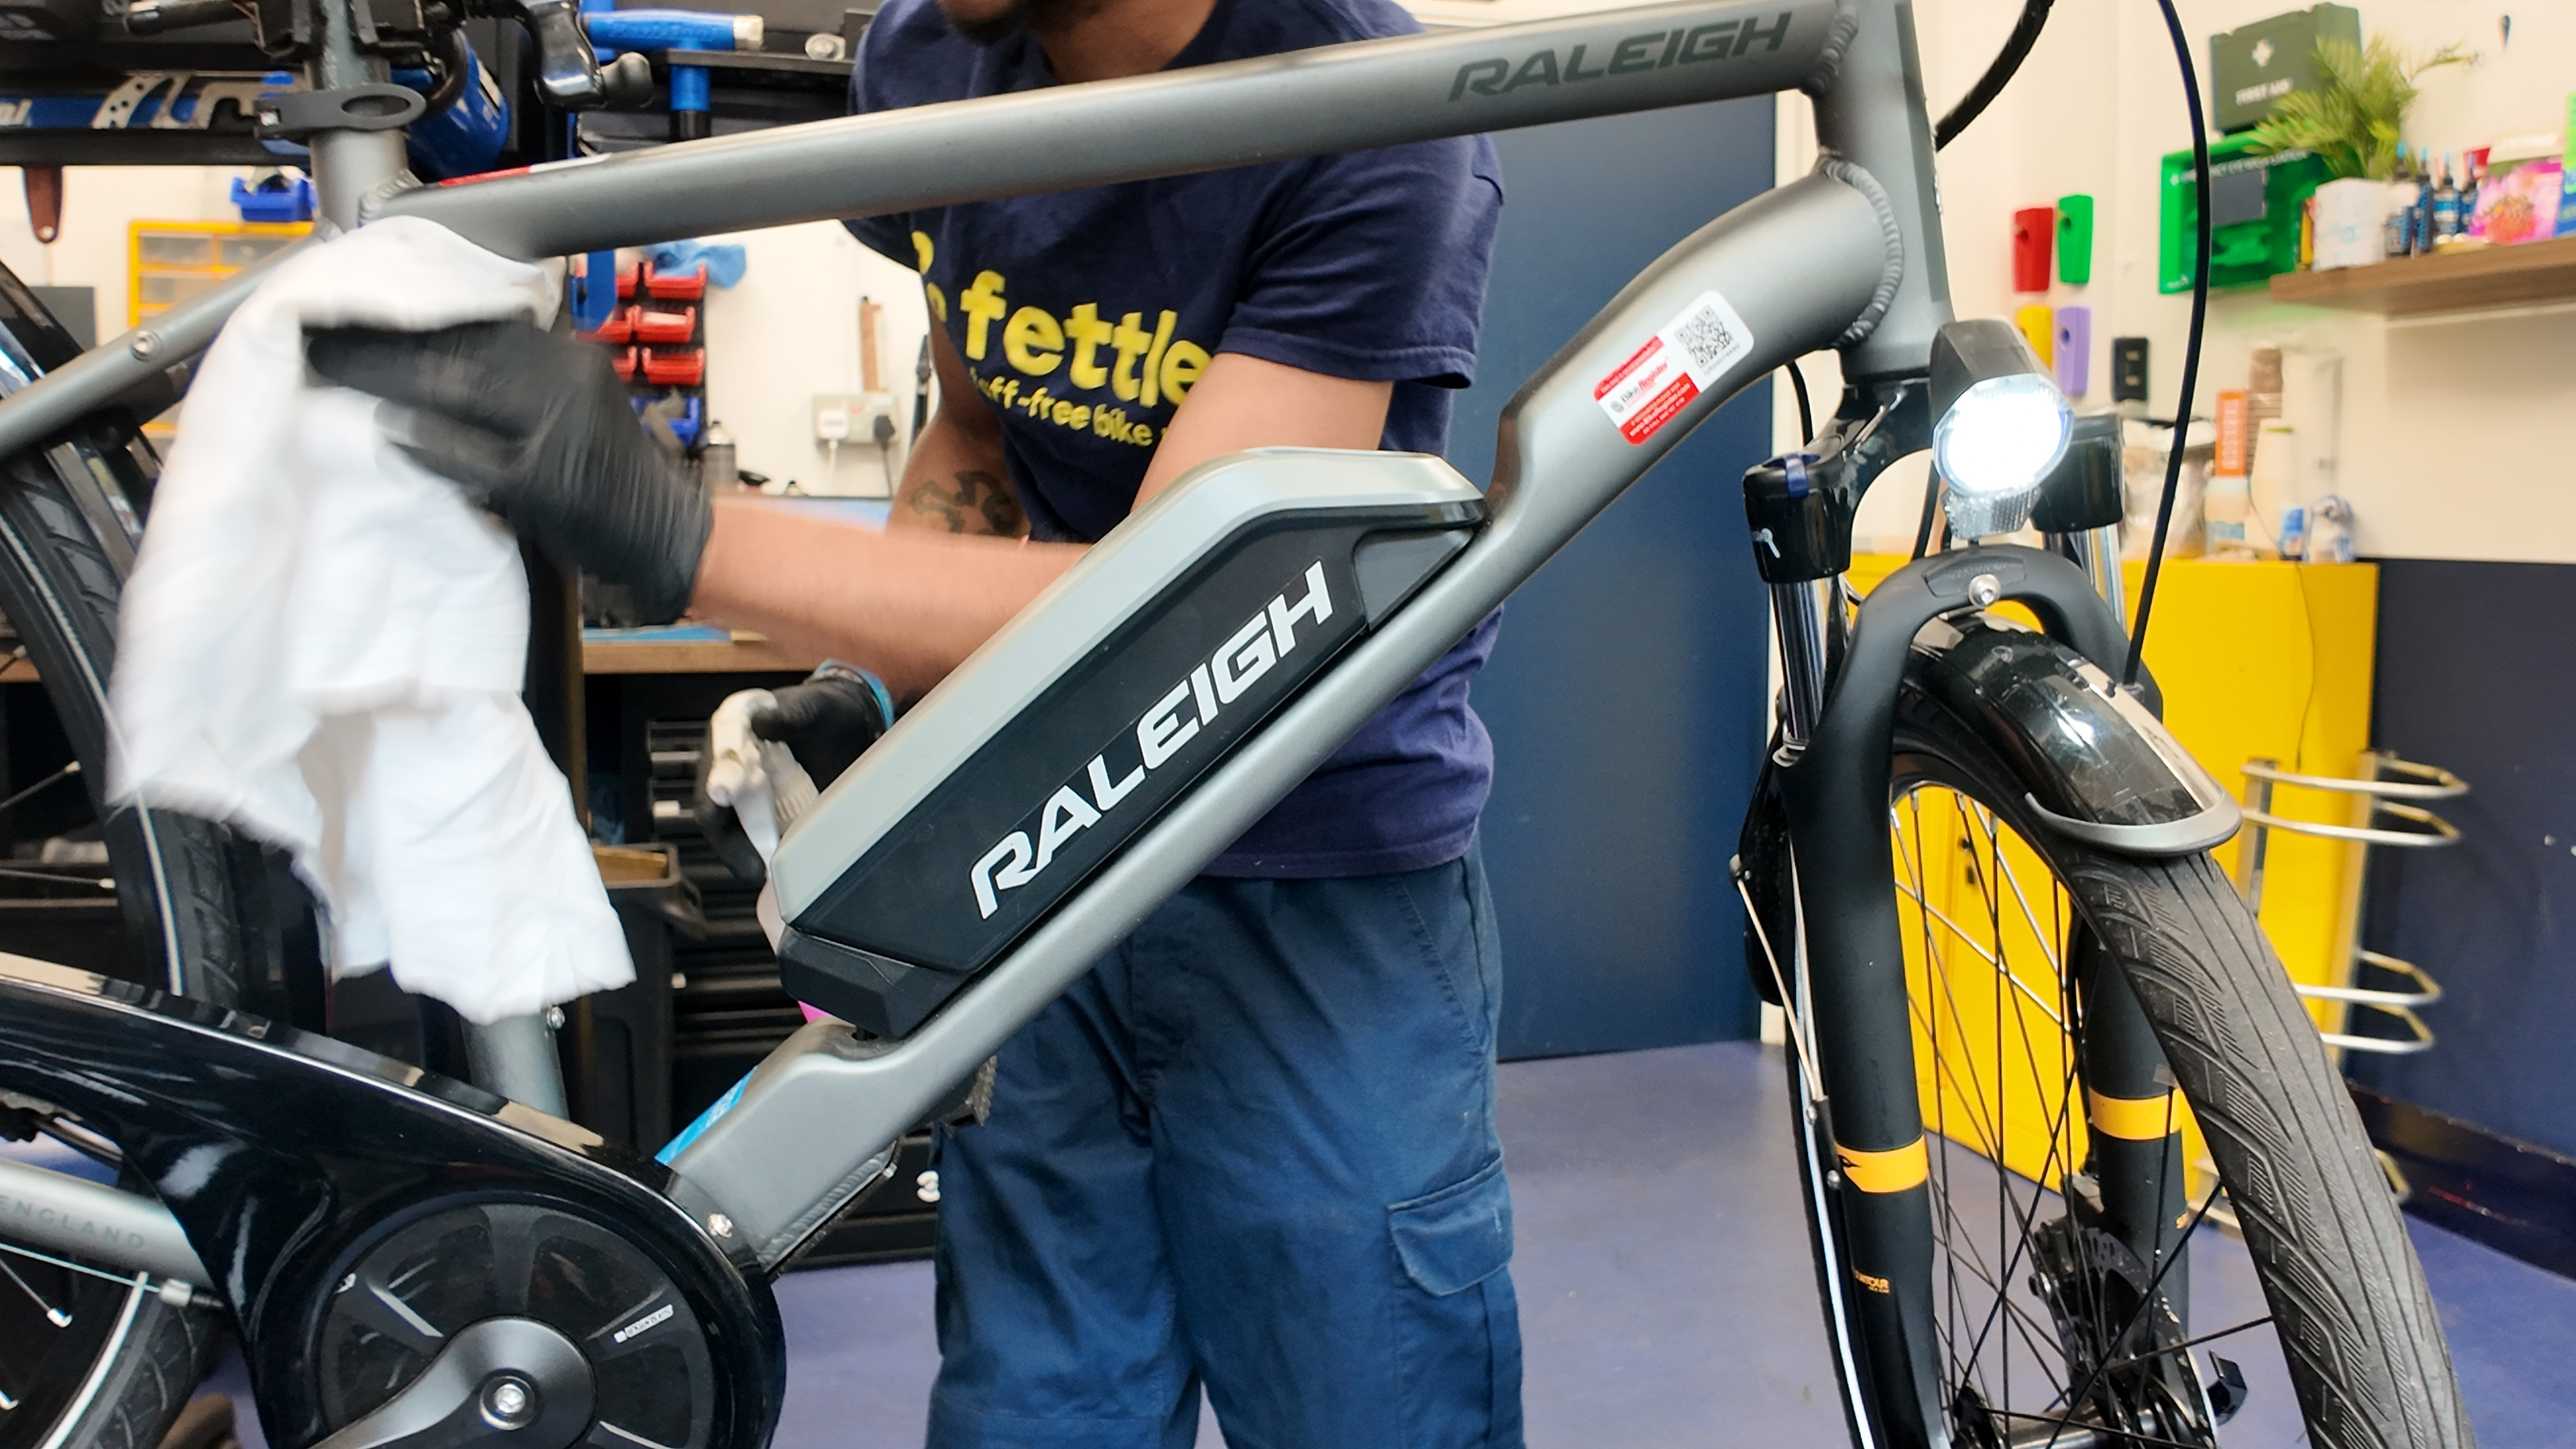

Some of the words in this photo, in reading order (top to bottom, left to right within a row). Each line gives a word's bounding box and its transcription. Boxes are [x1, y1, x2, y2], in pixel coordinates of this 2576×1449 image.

[1448, 12, 1792, 102] RALEIGH
[960, 270, 1212, 407] fettle
[1093, 403, 1153, 447] bike
[971, 560, 1334, 920] RALEIGH
